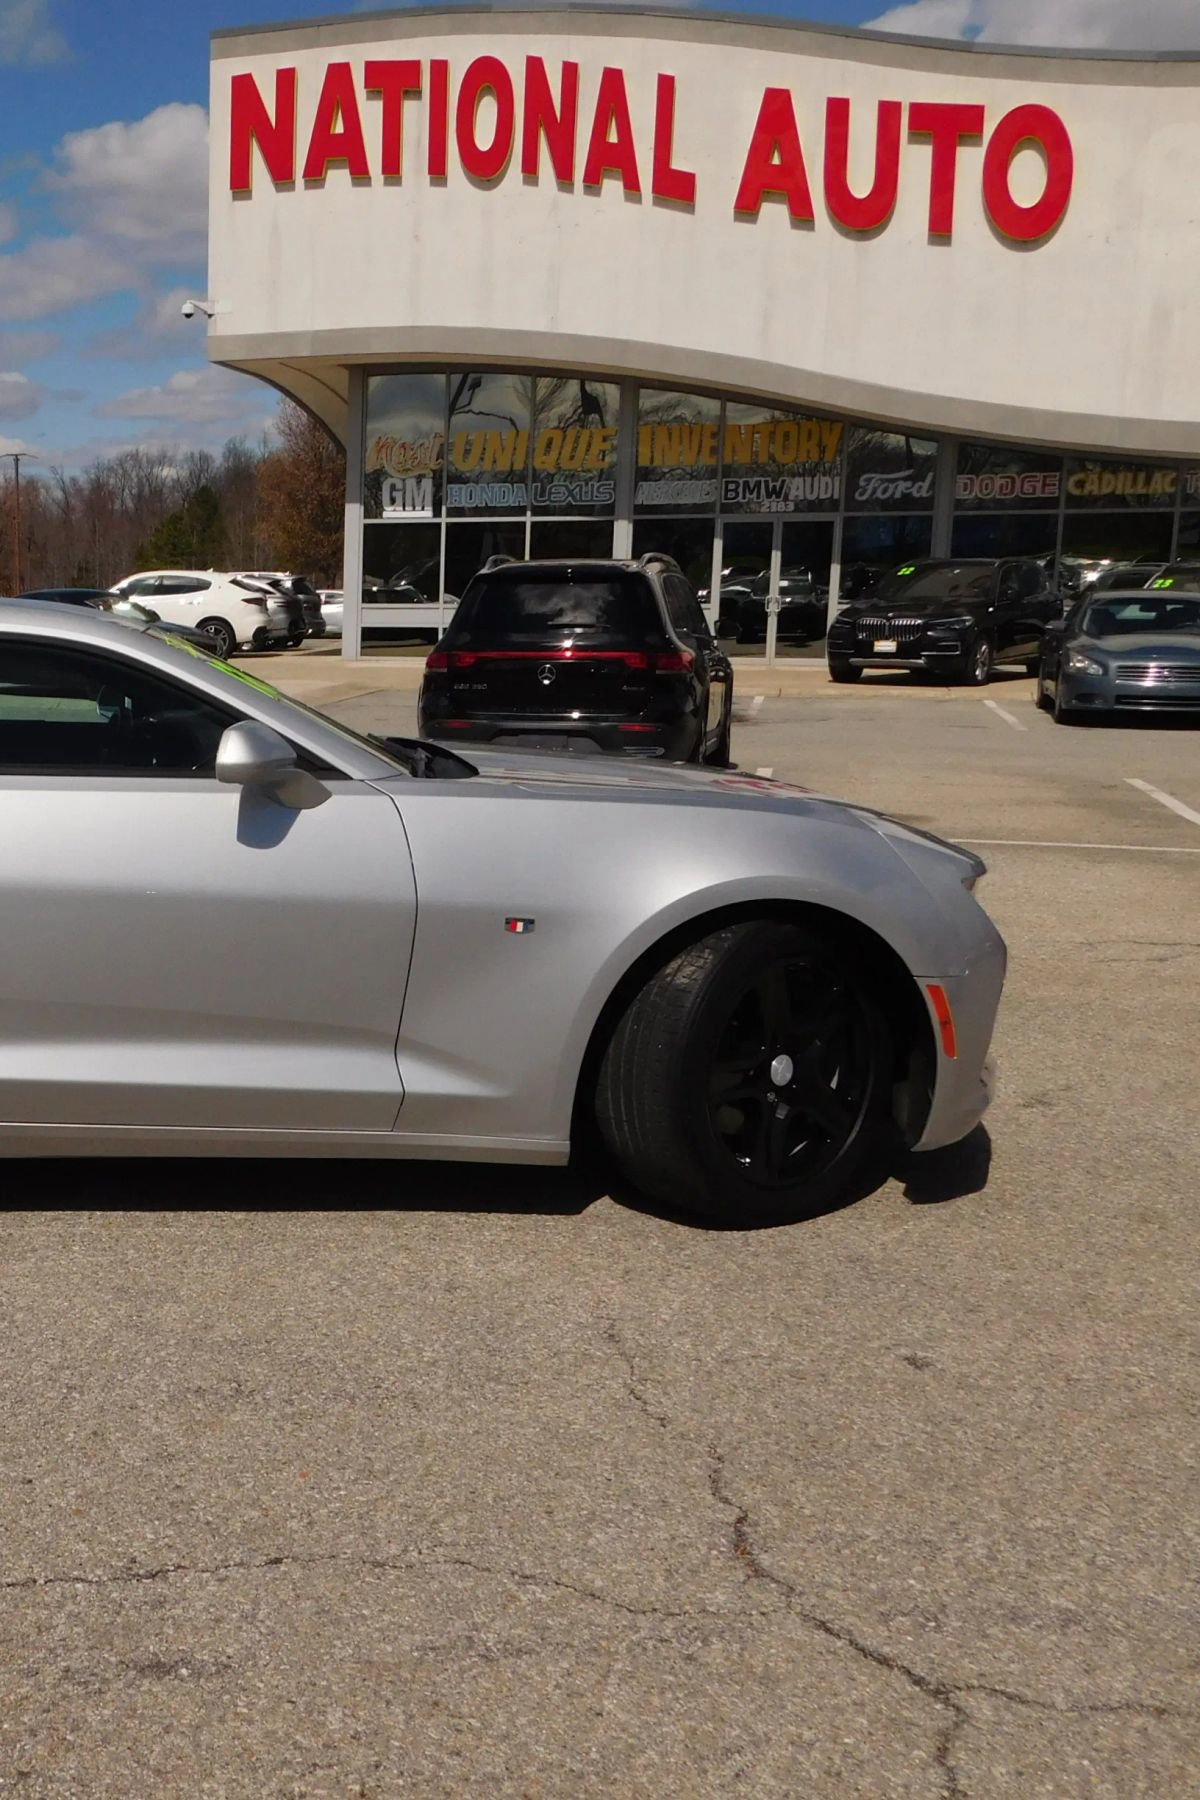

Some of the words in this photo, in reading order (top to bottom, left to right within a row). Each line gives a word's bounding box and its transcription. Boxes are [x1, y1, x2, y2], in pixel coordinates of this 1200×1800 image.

[230, 54, 696, 205] NATIONAL
[733, 87, 1074, 241] AUTO
[454, 427, 617, 472] UNIQUE
[638, 420, 844, 466] INVENTORY
[382, 477, 433, 512] GM
[447, 483, 529, 508] HONDA
[531, 480, 616, 506] LEXUS
[722, 477, 788, 502] BMW
[788, 475, 840, 500] AUDI
[854, 468, 934, 500] Ford
[955, 472, 1060, 499] DODGE
[1066, 469, 1177, 496] CADILLAC
